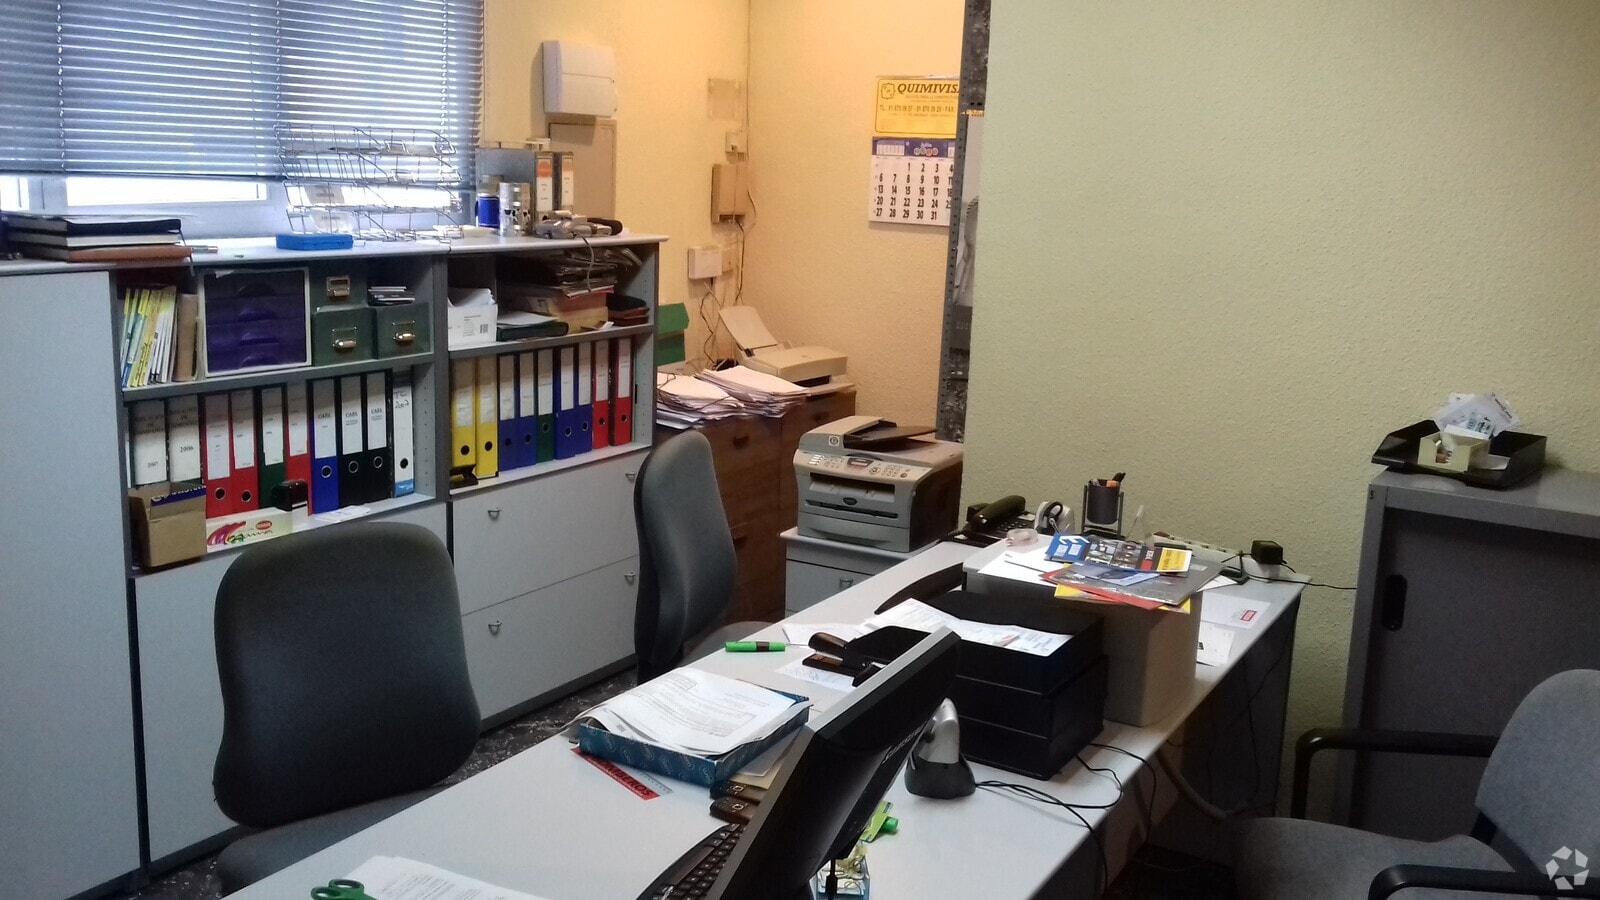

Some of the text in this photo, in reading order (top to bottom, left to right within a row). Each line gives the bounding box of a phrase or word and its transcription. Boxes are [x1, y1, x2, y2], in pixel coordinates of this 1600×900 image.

[897, 83, 959, 95] QUIMIVIS
[907, 162, 911, 171] 1
[921, 163, 925, 172] 2
[935, 163, 939, 173] 3
[879, 173, 883, 182] 6
[893, 173, 897, 182] 7
[906, 174, 910, 183] 8
[920, 175, 924, 184] 9
[933, 175, 939, 185] 10
[878, 184, 883, 194] 13
[891, 185, 897, 194] 14
[905, 186, 911, 195] 15
[918, 186, 925, 196] 16
[933, 187, 939, 196] 17
[877, 196, 883, 205] 20
[890, 197, 896, 206] 21
[903, 197, 910, 207] 22
[917, 198, 924, 208] 23
[931, 199, 938, 208] 24
[876, 207, 937, 220] 27 28 29 30 31
